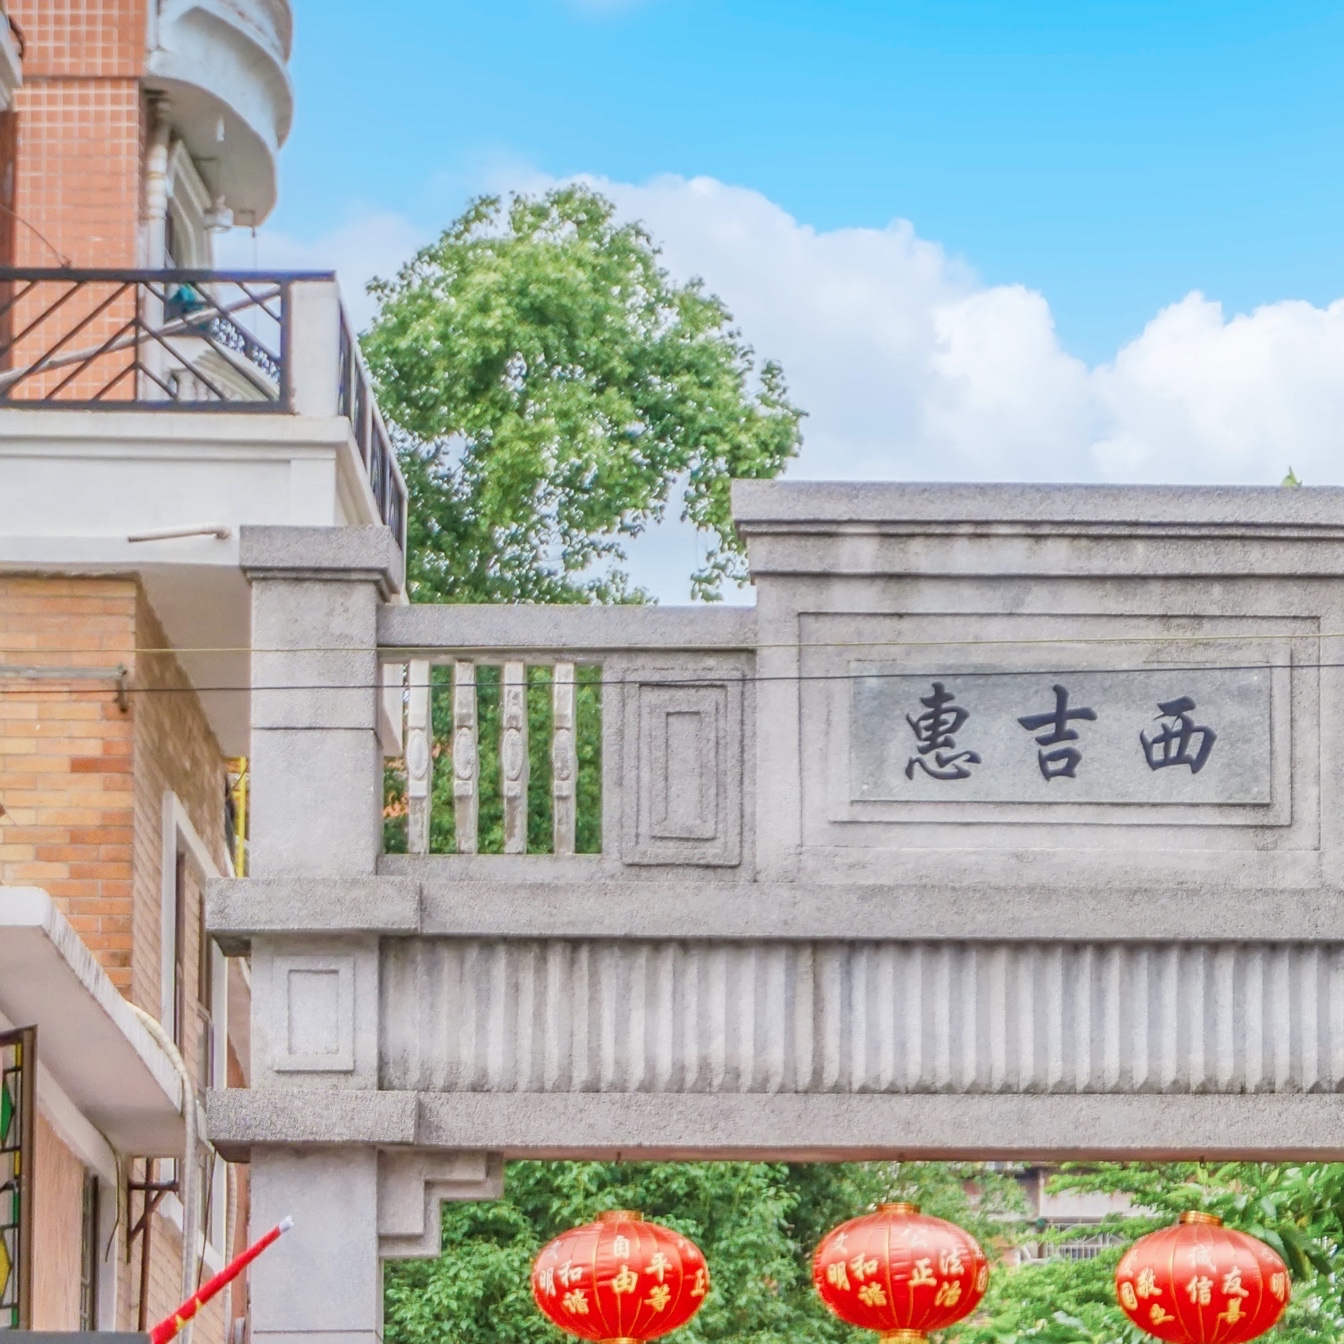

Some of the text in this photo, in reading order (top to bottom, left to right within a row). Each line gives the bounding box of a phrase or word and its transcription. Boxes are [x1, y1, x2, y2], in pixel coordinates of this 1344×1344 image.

[904, 681, 1218, 782] 惠吉西
[539, 1239, 562, 1297] 文明
[558, 1259, 589, 1315] 和谐
[611, 1235, 638, 1294] 自由
[644, 1251, 672, 1313] 平等
[826, 1231, 850, 1292] 文明
[851, 1253, 887, 1307] 和谐
[902, 1228, 938, 1287] 公正
[934, 1248, 965, 1308] 法治
[1186, 1245, 1217, 1306] 诚信
[1217, 1265, 1249, 1325] 友善
